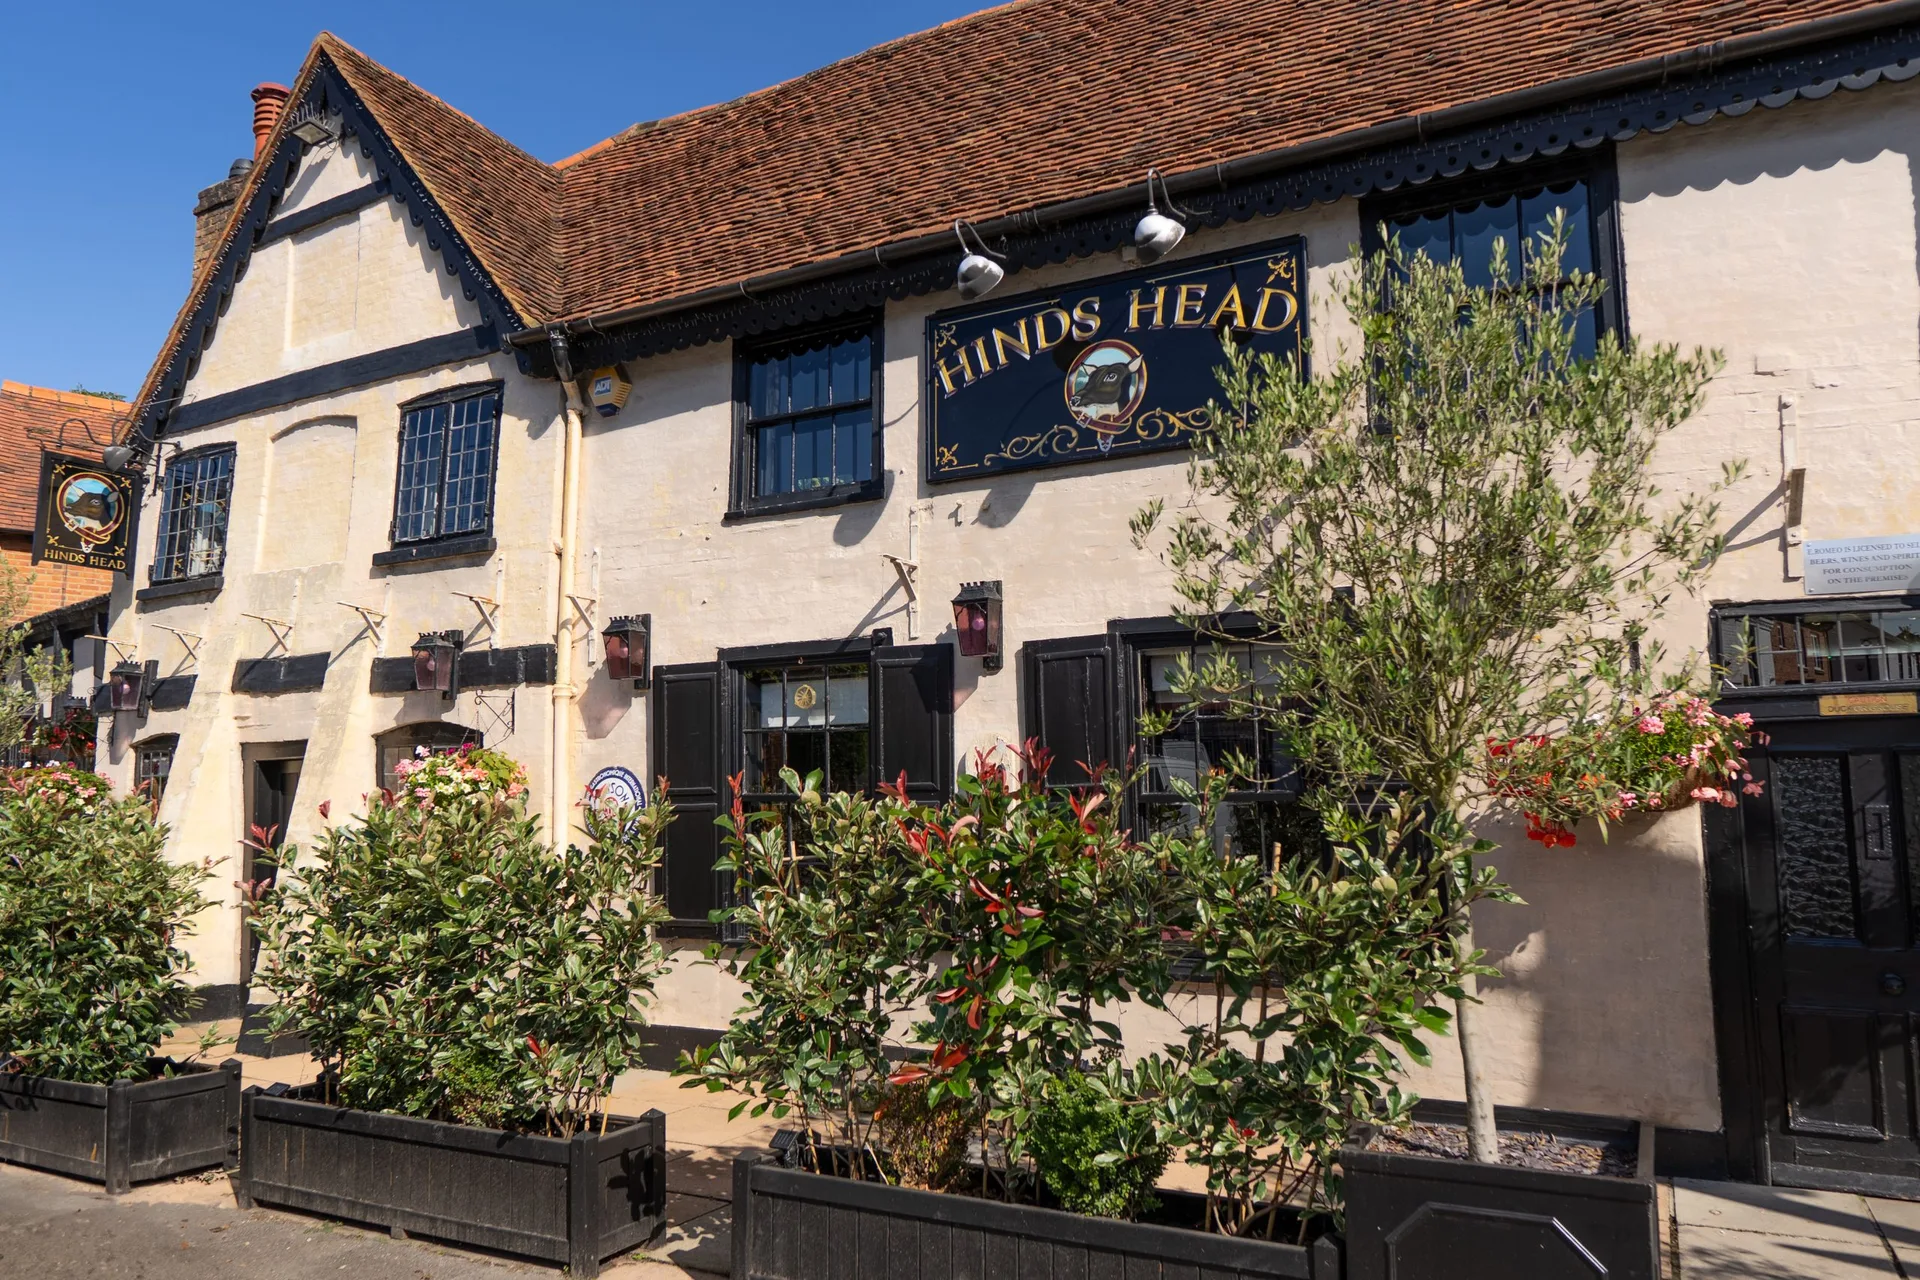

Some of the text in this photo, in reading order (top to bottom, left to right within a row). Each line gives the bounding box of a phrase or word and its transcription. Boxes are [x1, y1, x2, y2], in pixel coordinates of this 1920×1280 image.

[934, 283, 1299, 399] HINDS HEAD
[595, 379, 611, 392] ADT
[1852, 543, 1892, 552] LICENSED
[44, 548, 126, 569] HINDS HEAD
[1841, 555, 1868, 563] WINES
[1843, 564, 1912, 573] CONSUMPTION
[1864, 574, 1909, 582] PREMISES
